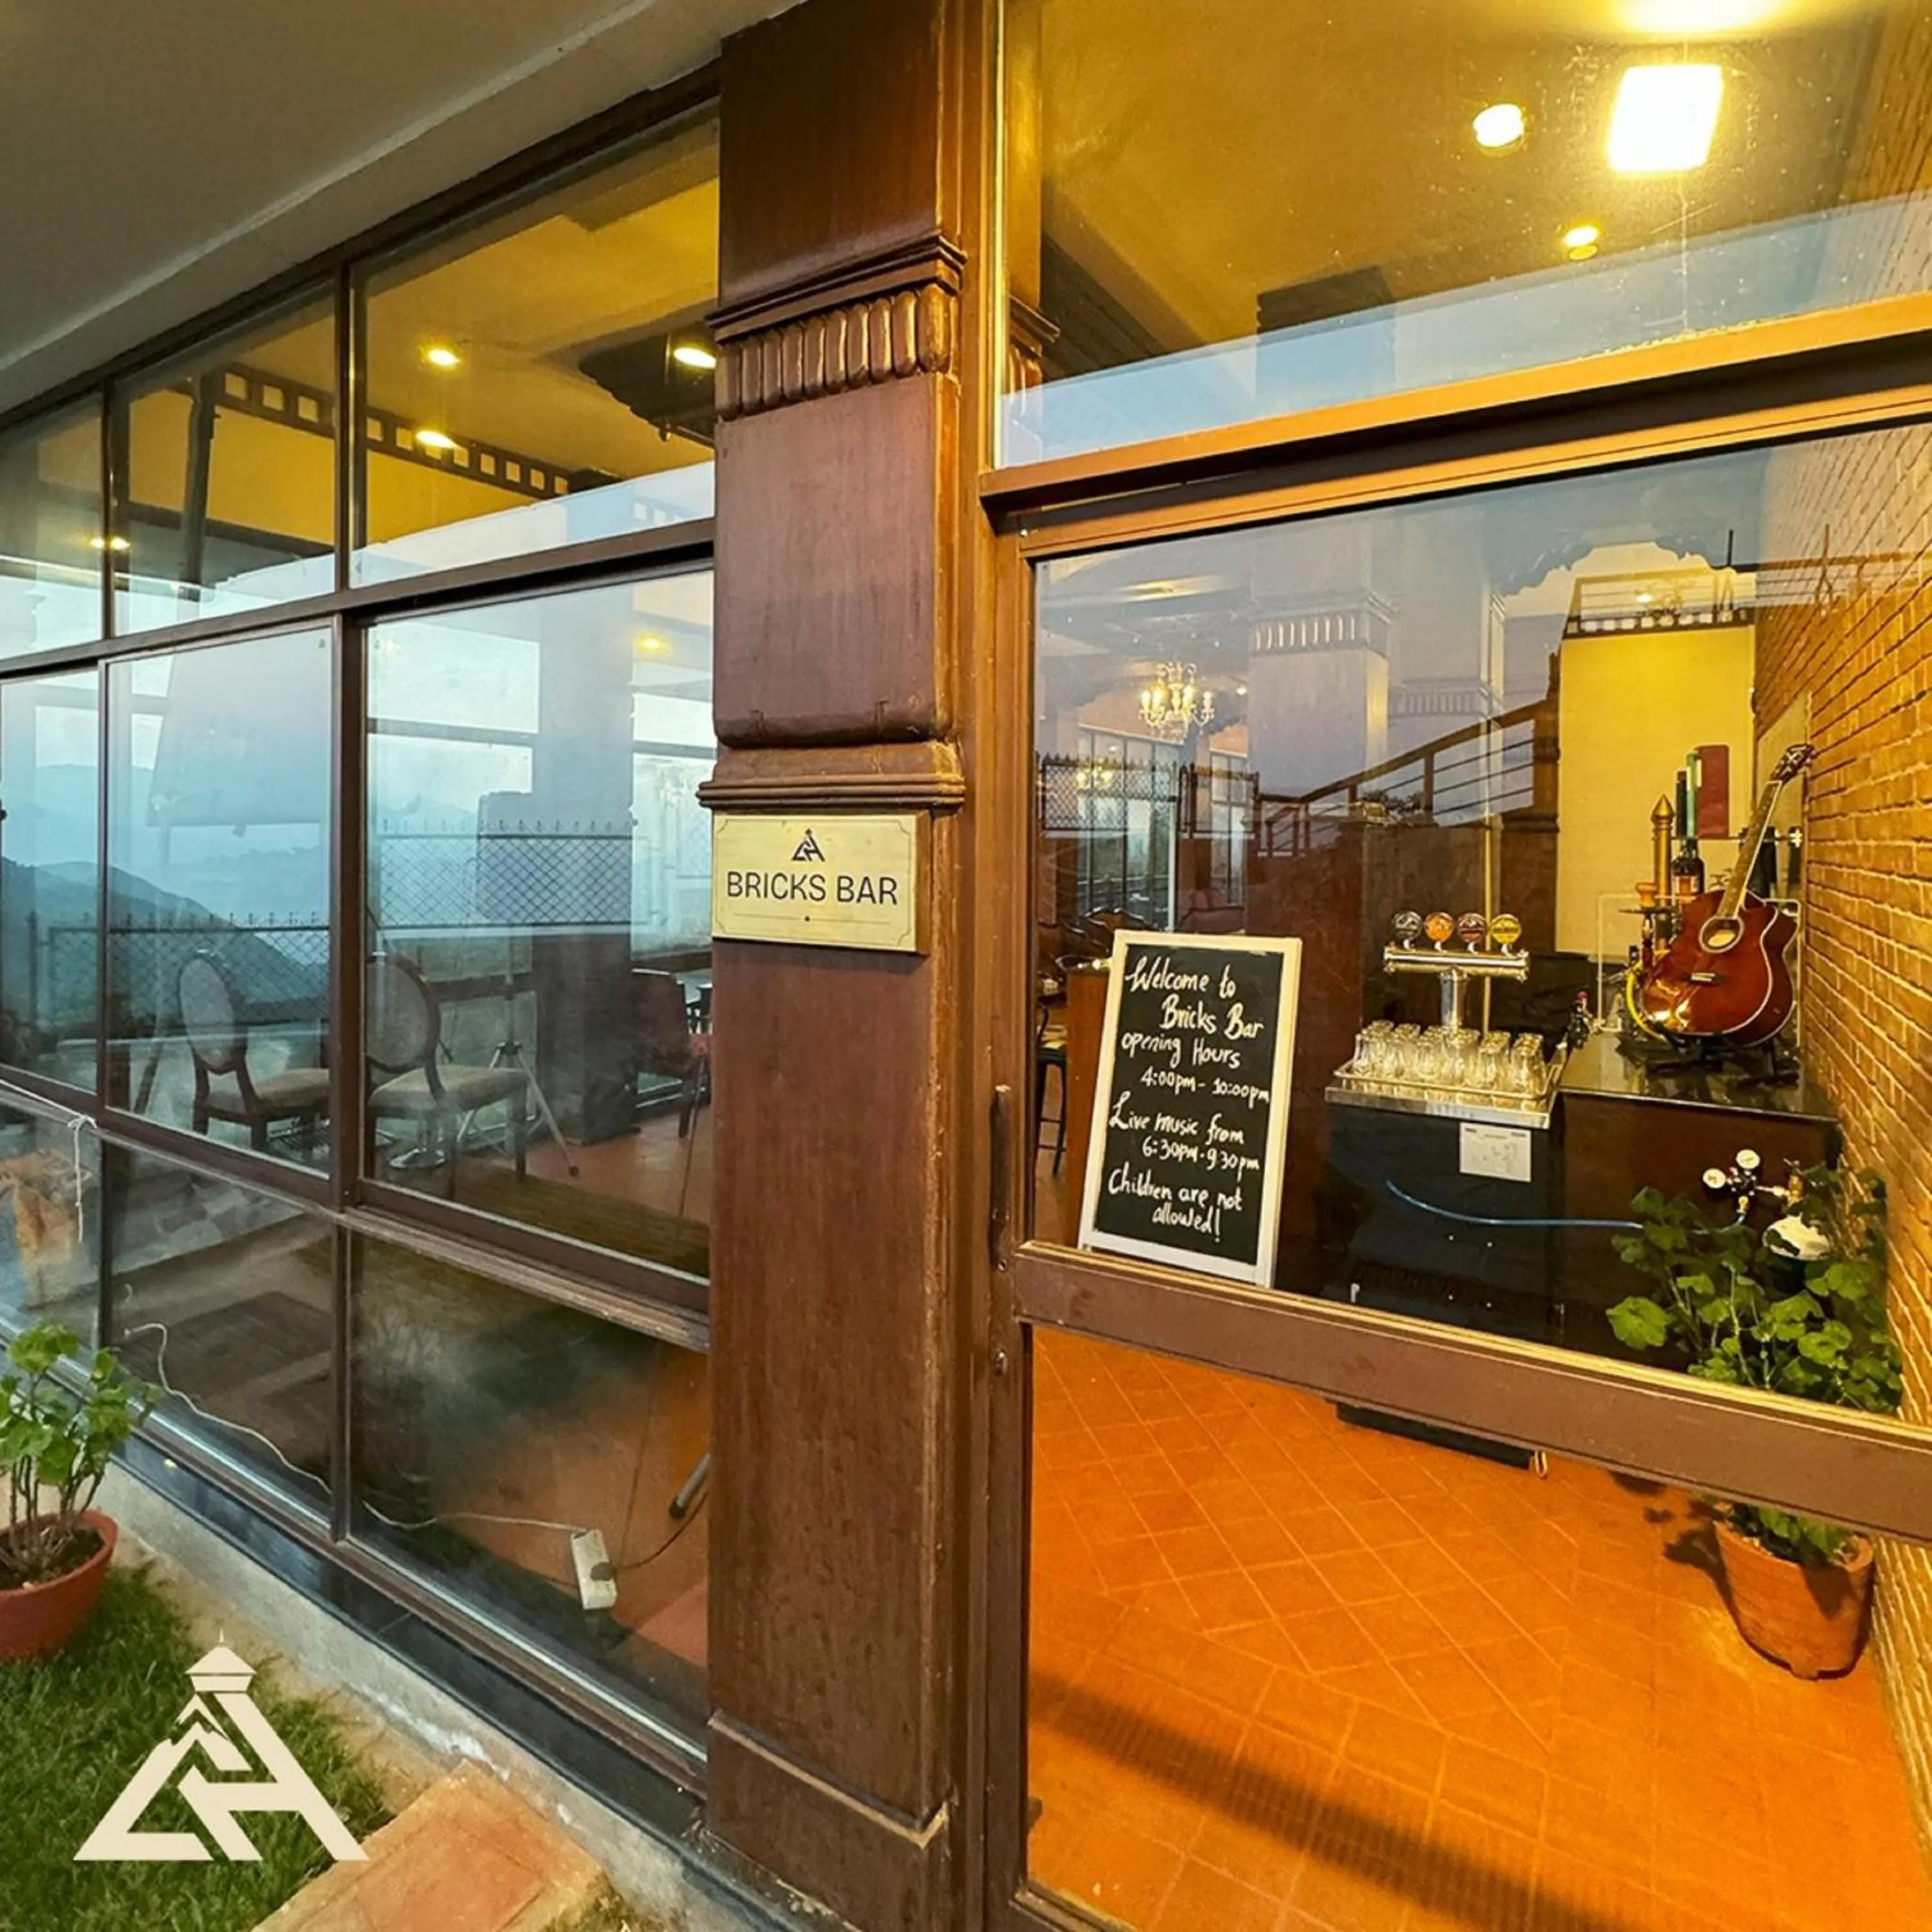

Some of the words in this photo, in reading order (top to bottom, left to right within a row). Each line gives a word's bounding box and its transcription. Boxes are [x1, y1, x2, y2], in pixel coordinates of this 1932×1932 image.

[727, 871, 826, 902] BRICKS
[837, 875, 898, 905] BAR
[1124, 956, 1209, 992] Welcome
[1219, 964, 1236, 998] to
[1159, 993, 1217, 1034] Bricks
[1224, 1002, 1264, 1041] Bar
[1192, 1038, 1242, 1070] Hours
[1108, 1090, 1151, 1130] Live
[1205, 1113, 1245, 1145] from
[1108, 1161, 1173, 1200] Children
[1178, 1186, 1209, 1208] are
[1217, 1187, 1242, 1211] not
[1151, 1203, 1221, 1243] allowed!
